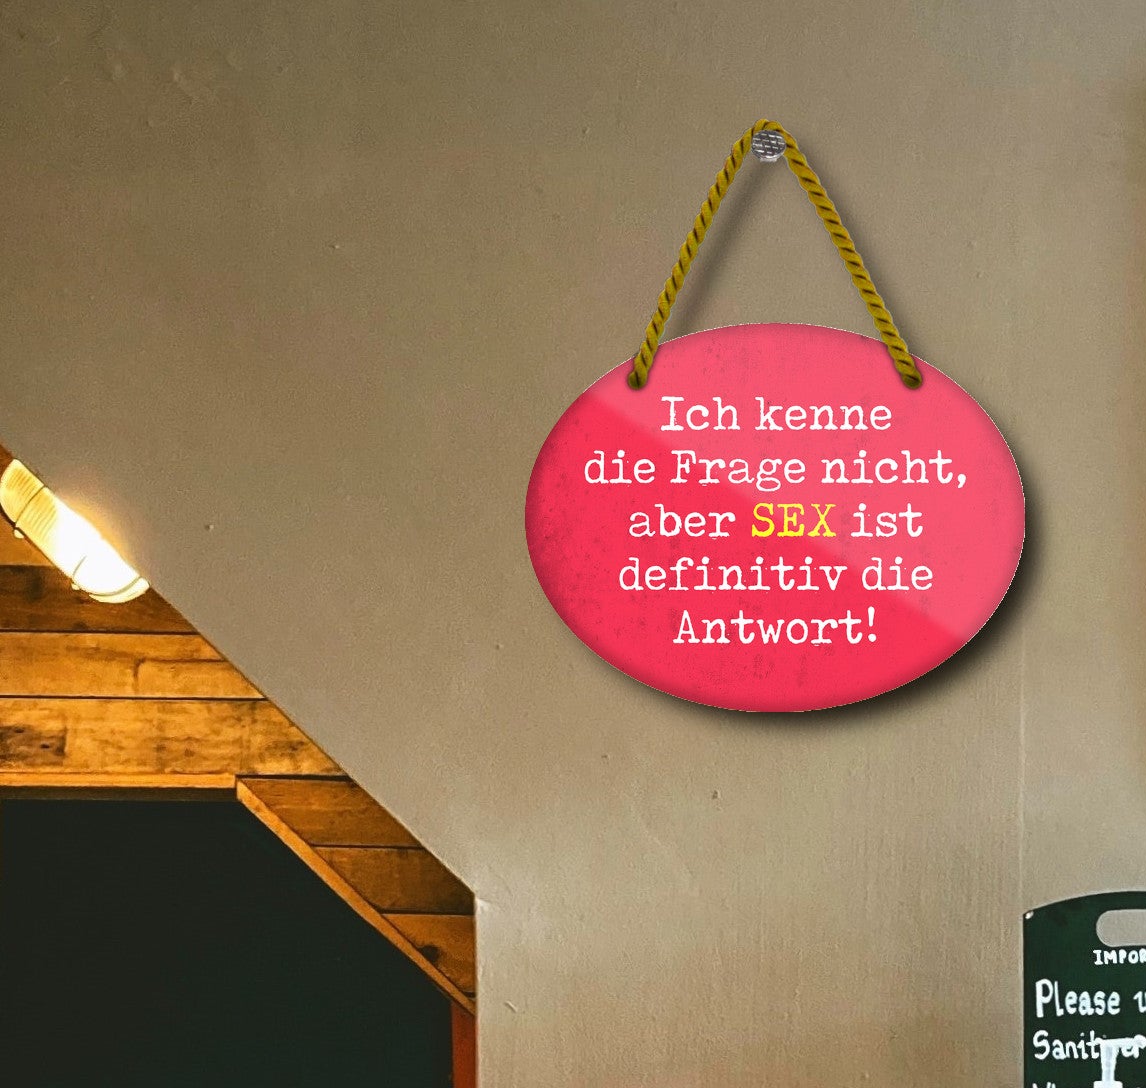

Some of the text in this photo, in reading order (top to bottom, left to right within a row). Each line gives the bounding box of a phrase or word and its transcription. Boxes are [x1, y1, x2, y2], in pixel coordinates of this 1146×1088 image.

[660, 396, 892, 432] Ich kenne
[584, 450, 967, 492] die Frage nicht,
[628, 502, 924, 540] aber SEX ist
[619, 556, 933, 591] definitiv die
[672, 606, 877, 647] Antwort!
[1035, 978, 1121, 1018] Please
